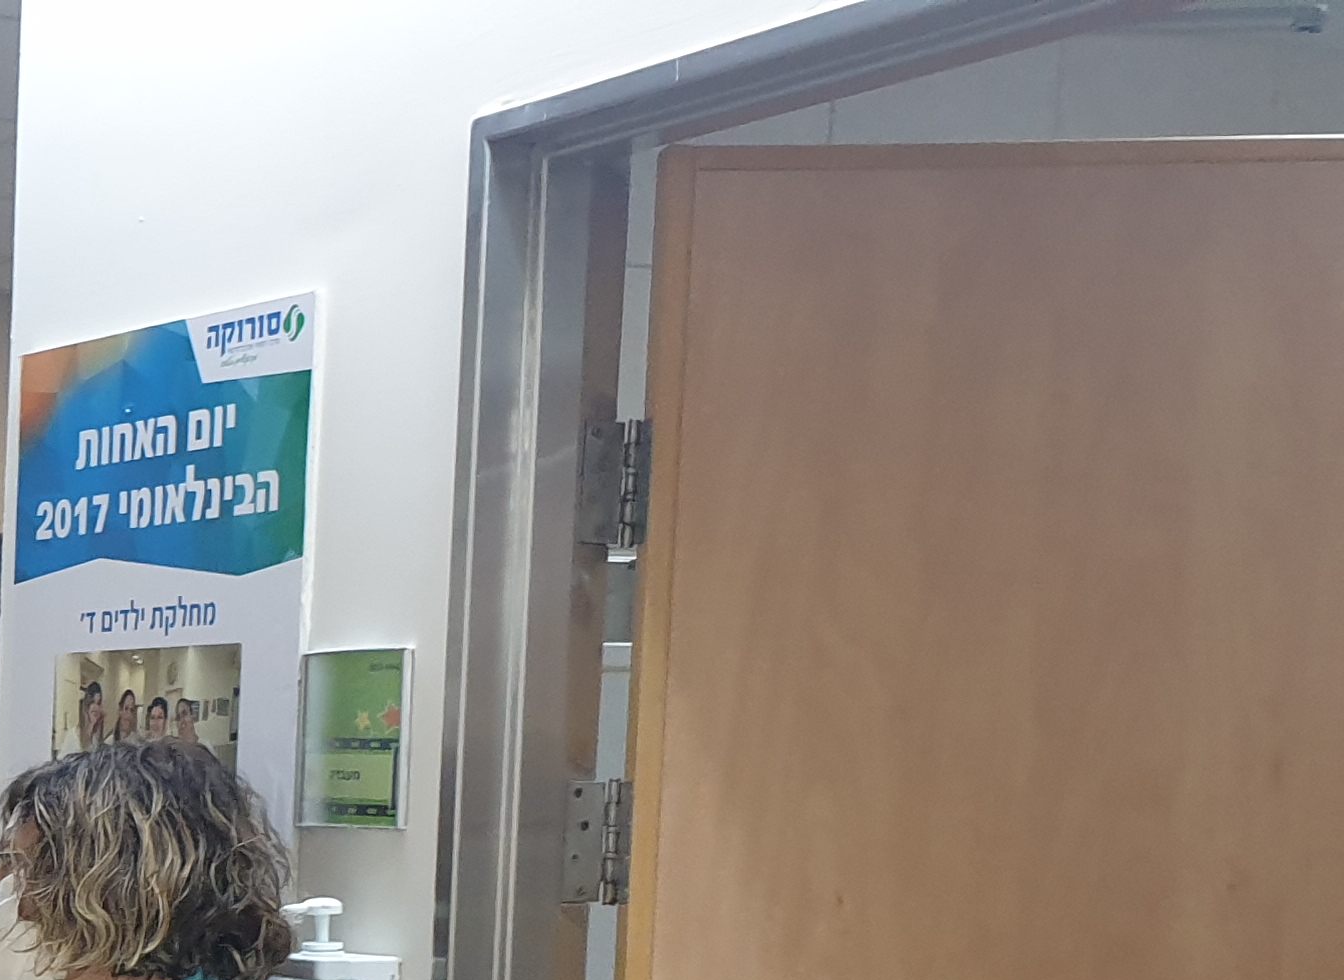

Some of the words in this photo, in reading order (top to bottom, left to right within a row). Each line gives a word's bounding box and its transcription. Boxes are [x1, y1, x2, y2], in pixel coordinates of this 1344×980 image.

[206, 310, 282, 358] סורוקה
[74, 414, 177, 471] האחות
[186, 402, 237, 452] יום
[34, 493, 110, 542] 2017
[118, 463, 280, 530] הבינלאומי
[101, 599, 146, 633] ילדים
[149, 595, 217, 637] מחלקת
